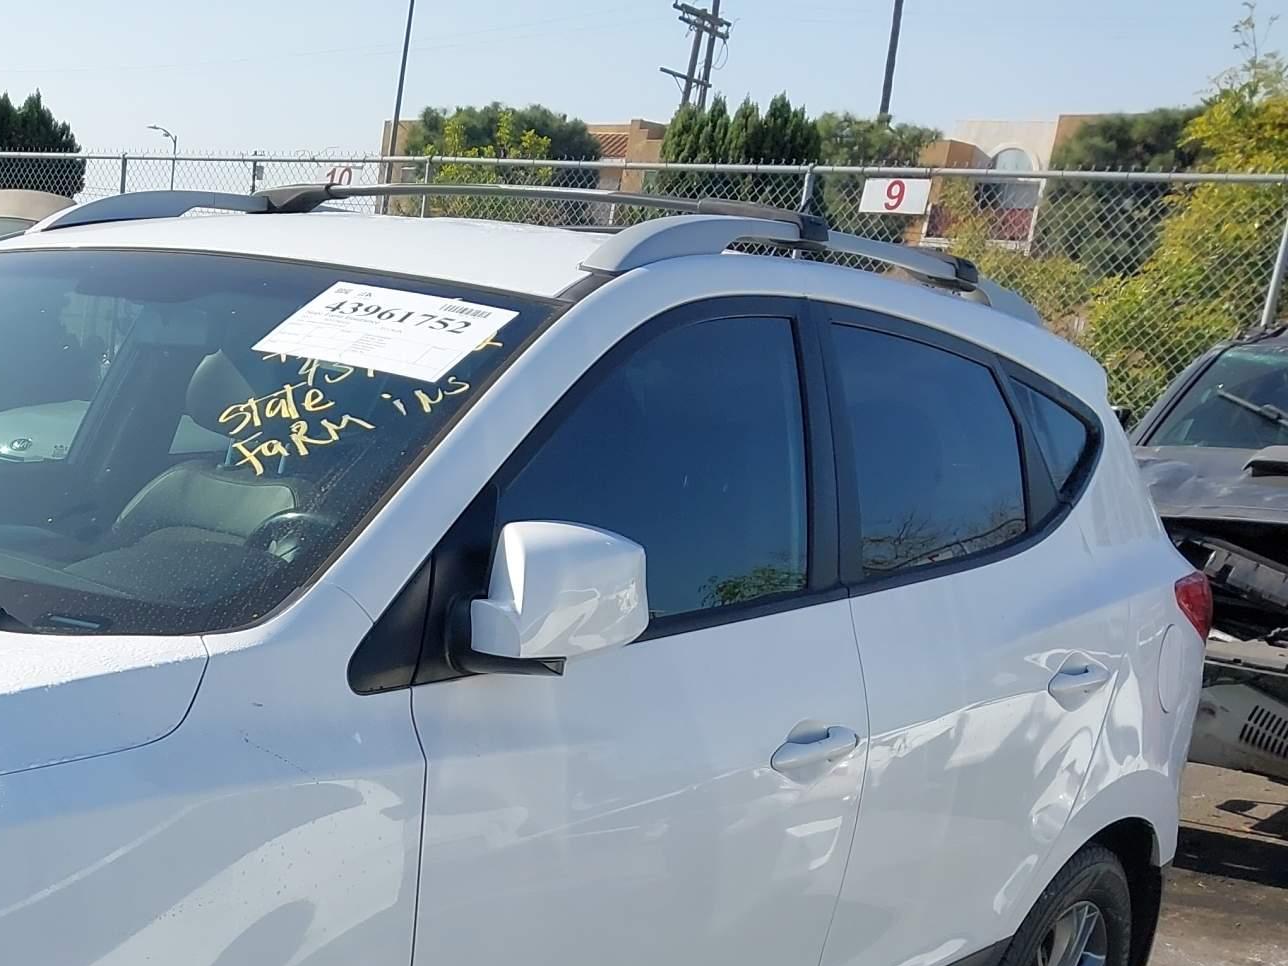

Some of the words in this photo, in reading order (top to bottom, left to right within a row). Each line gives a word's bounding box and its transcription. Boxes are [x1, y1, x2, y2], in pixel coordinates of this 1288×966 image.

[326, 167, 353, 185] 10
[884, 179, 906, 211] 9
[325, 299, 472, 334] 43961752
